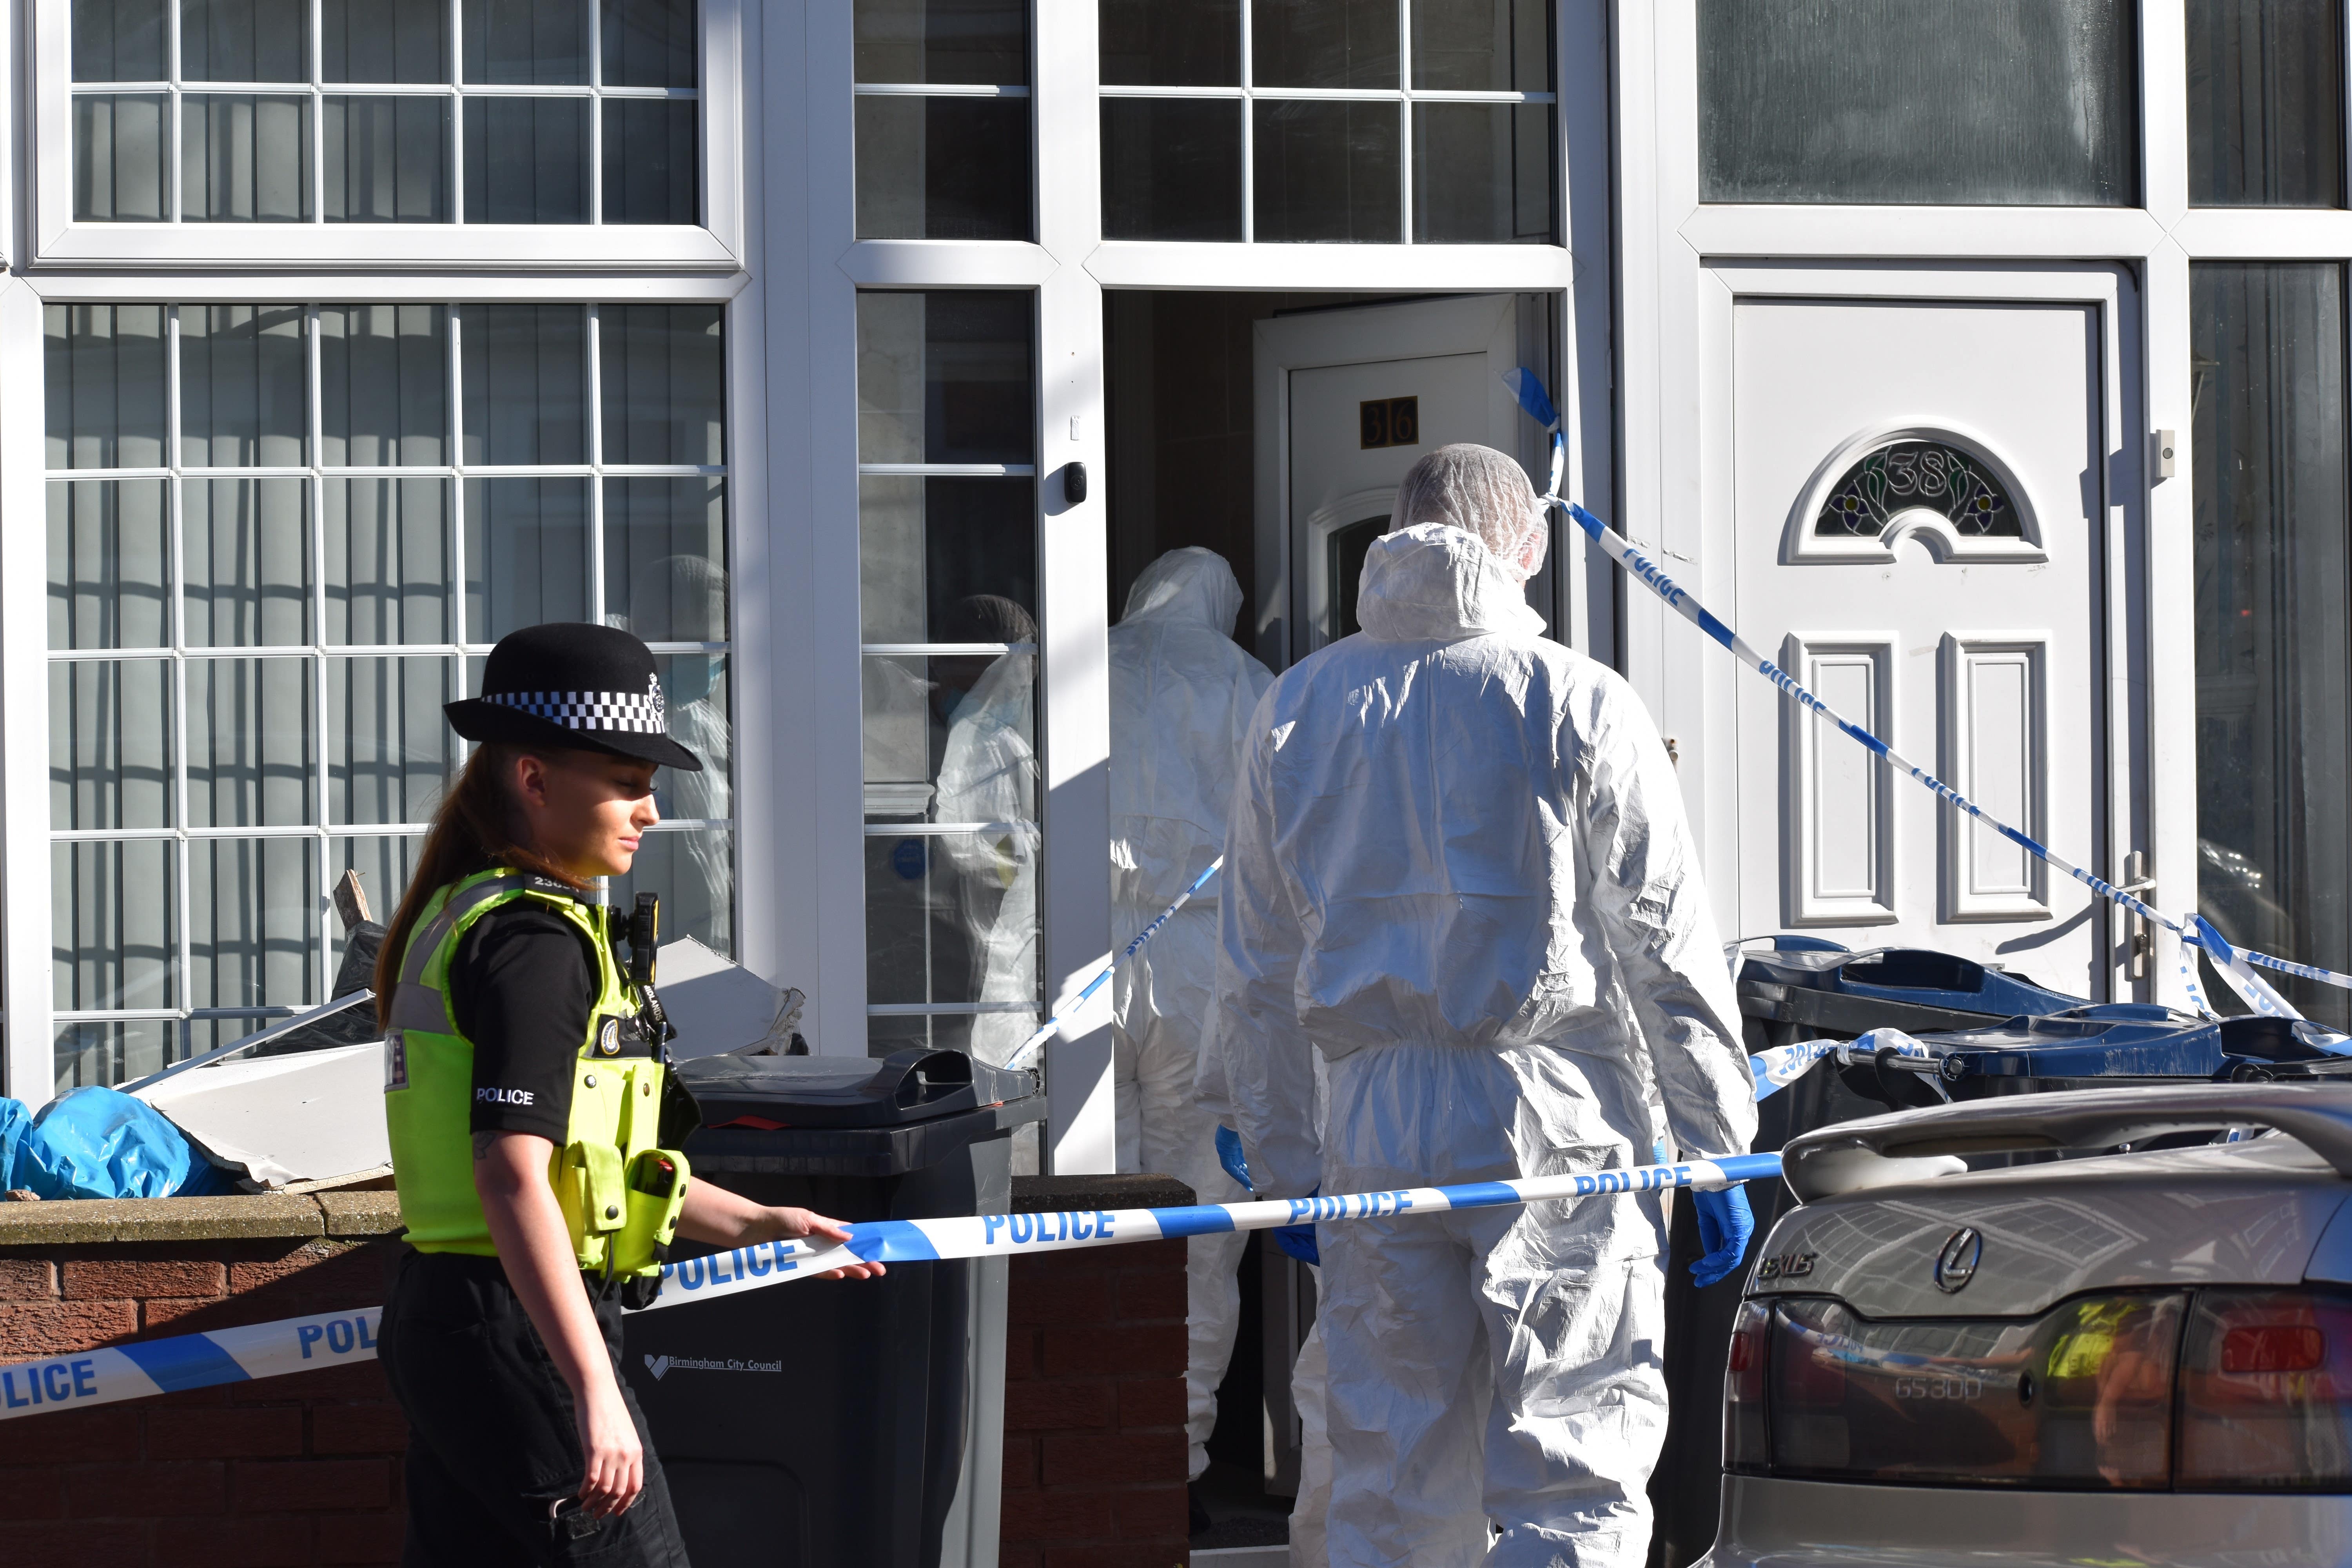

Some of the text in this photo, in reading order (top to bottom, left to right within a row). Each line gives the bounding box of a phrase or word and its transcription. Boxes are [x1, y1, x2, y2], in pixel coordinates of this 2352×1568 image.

[1367, 401, 1412, 443] 36
[1888, 451, 1947, 497] 38
[644, 985, 663, 1021] MIDLANDS
[477, 1087, 534, 1105] POLICE
[1573, 1166, 1692, 1197] POLICE
[1285, 1191, 1412, 1225] POLICE
[982, 1211, 1115, 1245] POLICE
[1757, 1253, 1817, 1279] LEXUS
[670, 1356, 782, 1371] Birmingham City Council
[0, 1359, 97, 1408] LICE
